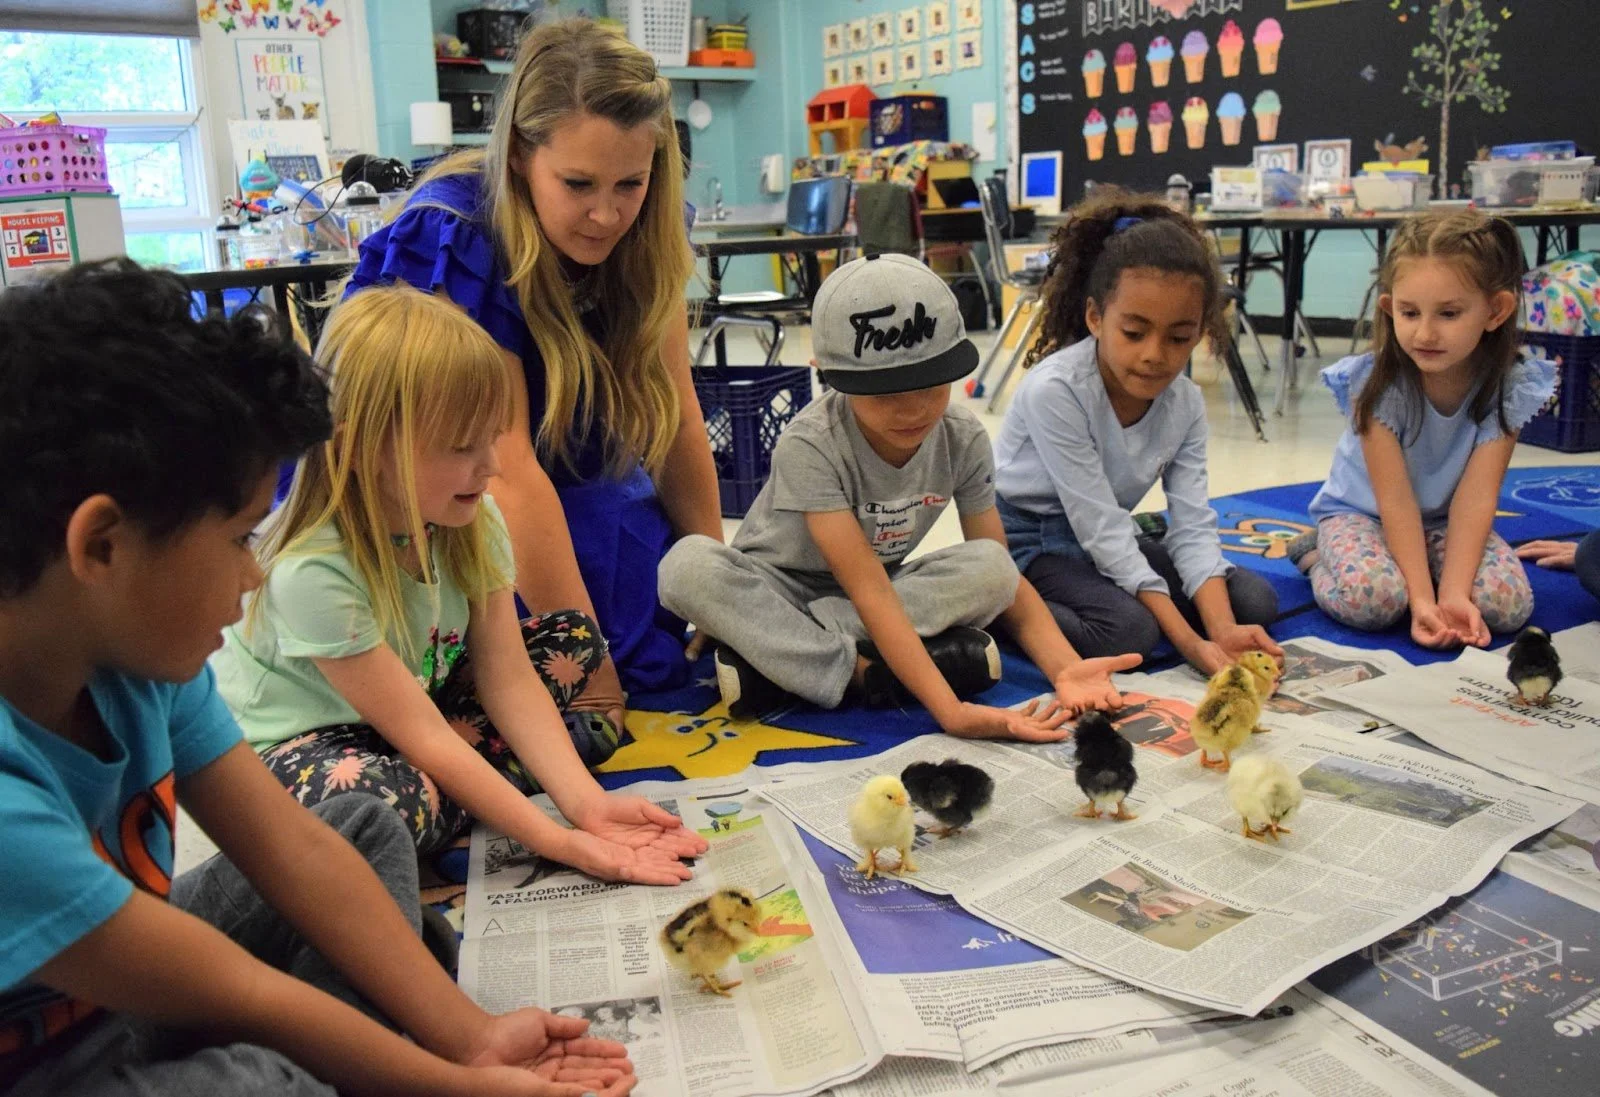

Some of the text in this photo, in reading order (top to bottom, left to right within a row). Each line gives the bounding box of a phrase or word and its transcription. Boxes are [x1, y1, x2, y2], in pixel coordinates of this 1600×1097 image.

[265, 44, 293, 54] OTHER
[253, 55, 304, 74] PEOPLE
[256, 75, 309, 93] MATTER
[8, 214, 60, 227] HOUSE KEEPING
[8, 231, 13, 241] 1
[55, 227, 61, 236] 3
[10, 246, 17, 255] 2
[56, 242, 63, 250] 4
[849, 302, 937, 358] Fresh
[1456, 687, 1576, 729] companies
[1400, 757, 1441, 775] UKRAINE
[1444, 771, 1477, 785] CRISIS
[1095, 835, 1131, 856] Interest
[1131, 850, 1142, 863] in
[1141, 858, 1170, 877] Bomb
[1170, 873, 1210, 898] Shelters
[1210, 891, 1242, 907] Grows
[1255, 905, 1294, 918] Poland
[487, 892, 524, 900] FAST
[527, 883, 601, 897] FORWARD
[505, 893, 569, 905] FASHION
[573, 883, 630, 898] LEGEND
[847, 884, 898, 895] shape
[482, 918, 504, 936] A
[993, 991, 1032, 1000] consider
[1050, 985, 1079, 993] Fund's
[943, 1009, 994, 1023] prospectus
[995, 1001, 1042, 1013] containing
[1043, 997, 1060, 1005] this
[1061, 992, 1113, 1002] information.
[945, 1005, 982, 1017] charges
[984, 1001, 1001, 1009] and
[1048, 990, 1069, 998] Visit
[953, 1015, 997, 1031] investing.
[1222, 1076, 1256, 1094] Crypto
